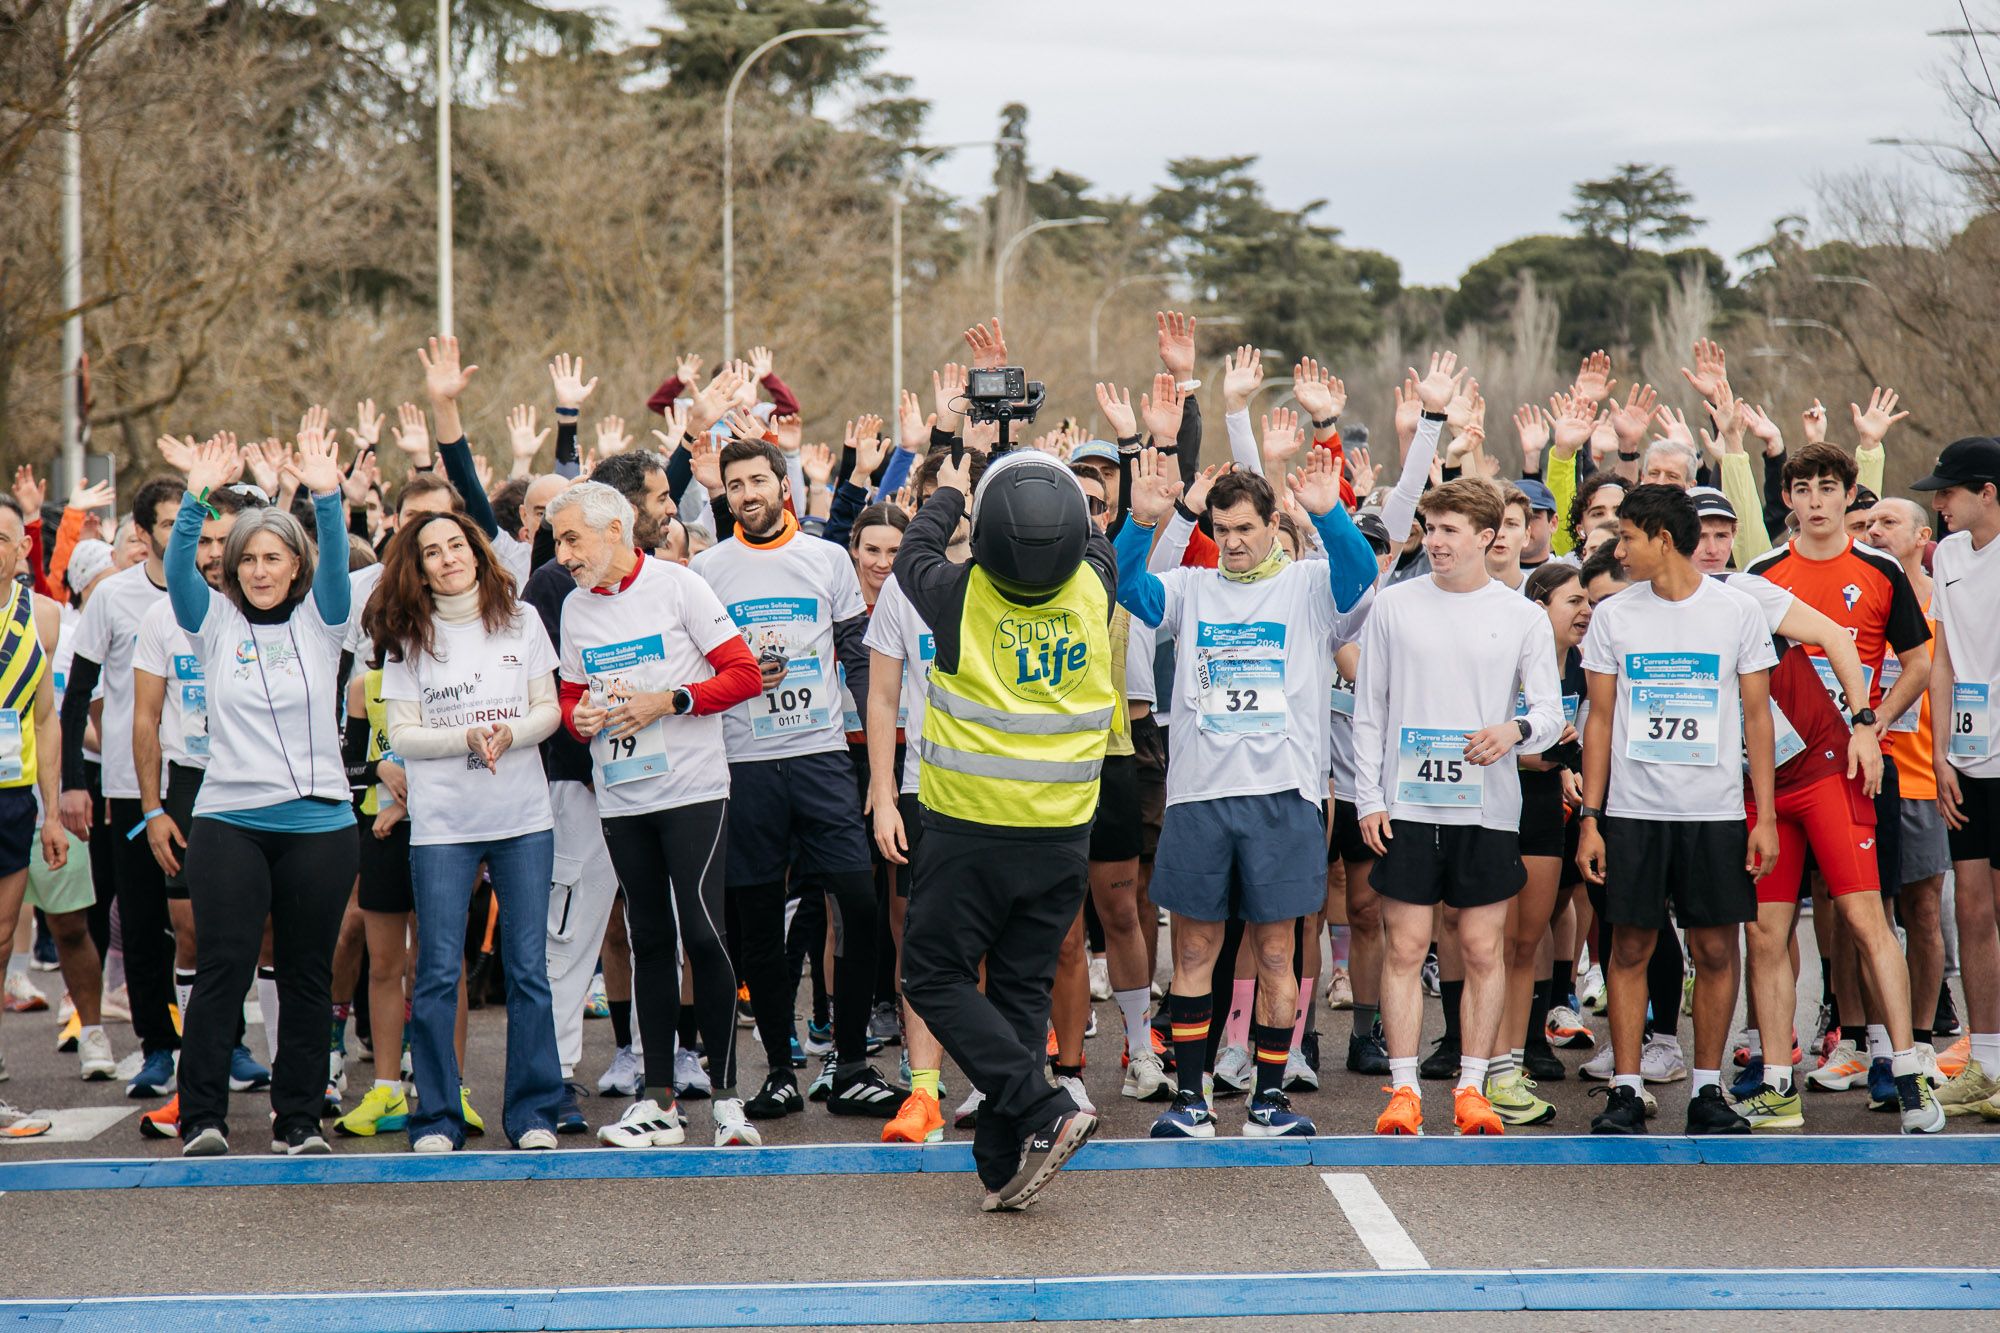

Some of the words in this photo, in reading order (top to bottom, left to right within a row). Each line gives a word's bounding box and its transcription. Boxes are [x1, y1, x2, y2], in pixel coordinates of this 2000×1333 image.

[793, 614, 814, 622] 2026
[999, 612, 1073, 650] Sport
[1256, 639, 1280, 648] 2026
[637, 653, 661, 664] 2026
[1015, 637, 1087, 686] Life
[1670, 657, 1699, 665] Solidaria
[1198, 665, 1210, 689] 0035
[1691, 672, 1715, 681] 2026
[423, 682, 475, 704] Siempre
[766, 688, 812, 714] 109
[1226, 689, 1258, 712] 32
[436, 704, 462, 715] puede
[485, 696, 504, 707] algo
[778, 715, 801, 727] 0117
[1648, 717, 1699, 740] 378
[609, 735, 636, 760] 79
[1416, 733, 1440, 741] Carrera
[1417, 760, 1463, 783] 415
